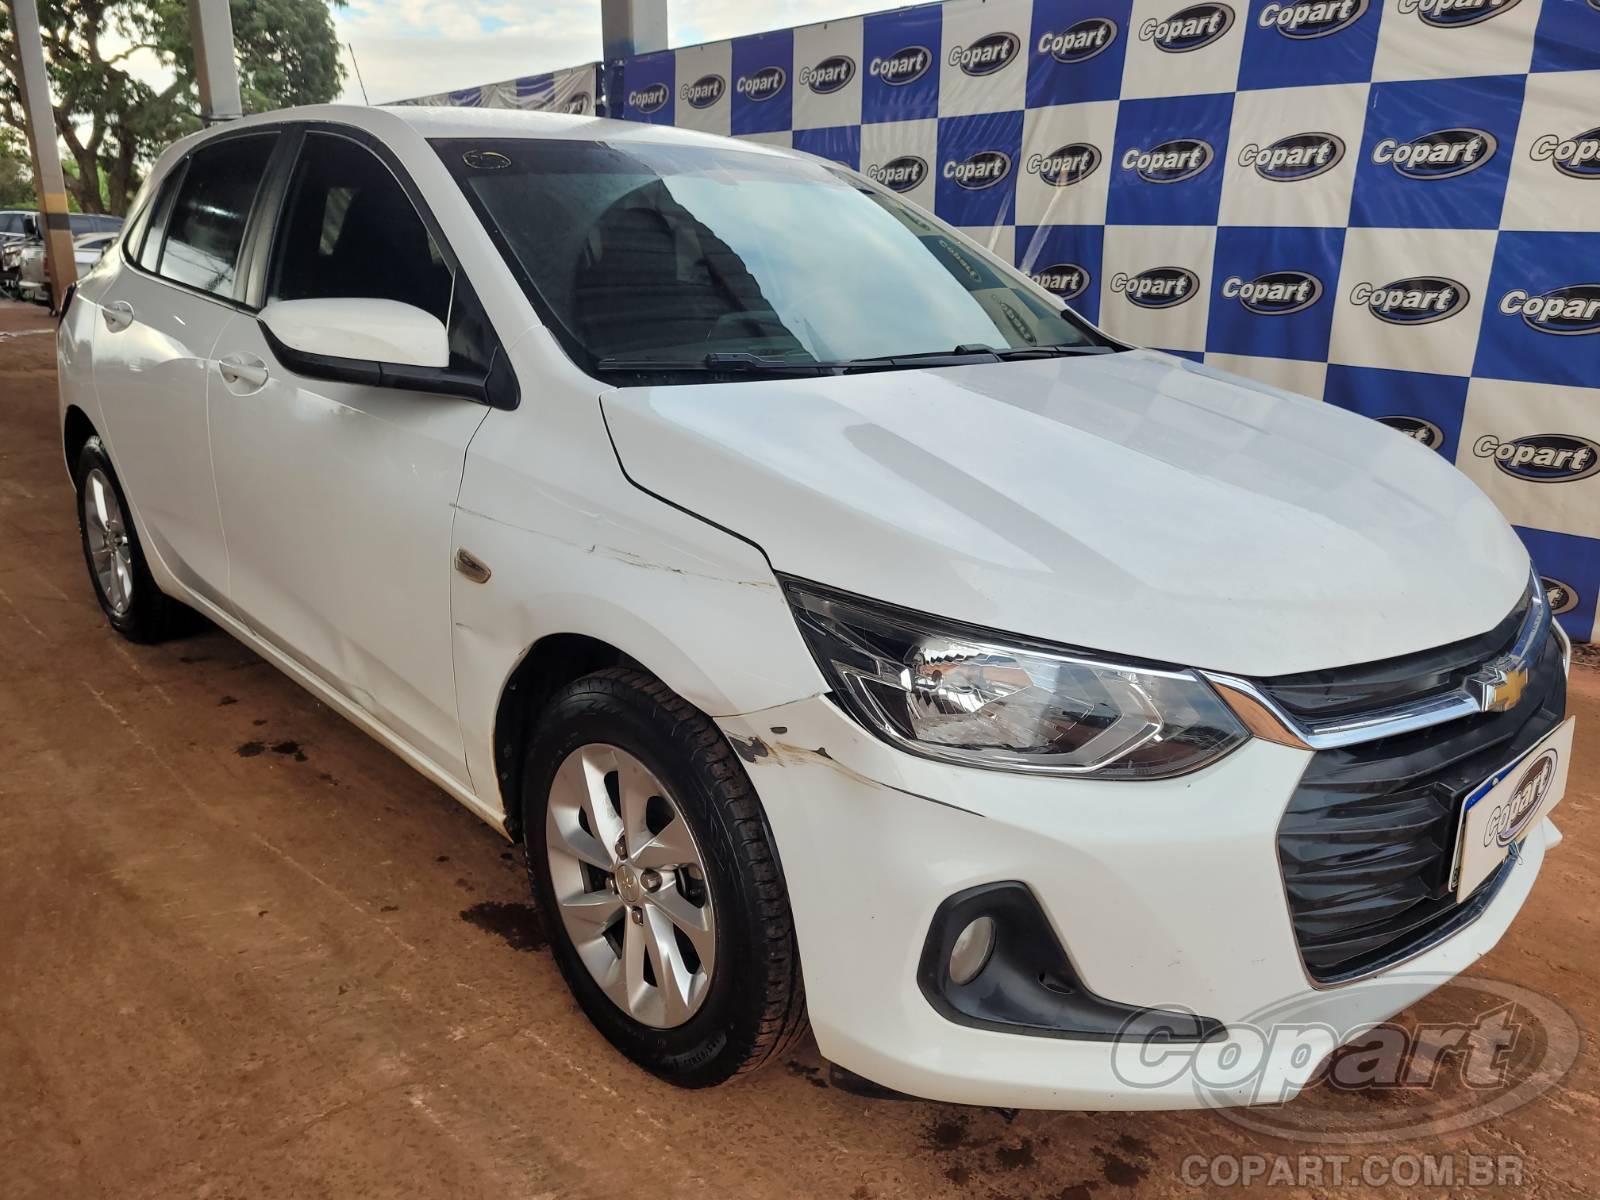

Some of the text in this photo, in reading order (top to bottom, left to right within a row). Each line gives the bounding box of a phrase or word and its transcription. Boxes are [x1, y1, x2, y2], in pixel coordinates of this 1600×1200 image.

[1258, 0, 1353, 31] Copart
[1398, 0, 1507, 17] Cop
[1039, 21, 1107, 53] Copart
[1139, 8, 1223, 42] Copart
[869, 51, 926, 76] Copart
[949, 38, 1011, 67] Copart
[737, 72, 782, 93] Copart
[800, 60, 849, 87] Copart
[628, 89, 666, 107] Copart
[680, 81, 722, 100] Copart
[1026, 149, 1091, 174] Copart
[1121, 146, 1206, 172] Copart
[1238, 140, 1335, 171] Copart
[1371, 135, 1484, 170] Copart
[1530, 134, 1600, 167] Cop
[866, 163, 920, 185] Copart
[943, 157, 1003, 180] Copart
[1025, 272, 1080, 290] opart
[1111, 271, 1190, 299] Copart
[1222, 277, 1313, 304] Copart
[1350, 282, 1457, 314] Copart
[1500, 289, 1600, 323] Copar
[1473, 435, 1590, 471] Copart
[1484, 761, 1551, 847] Copart
